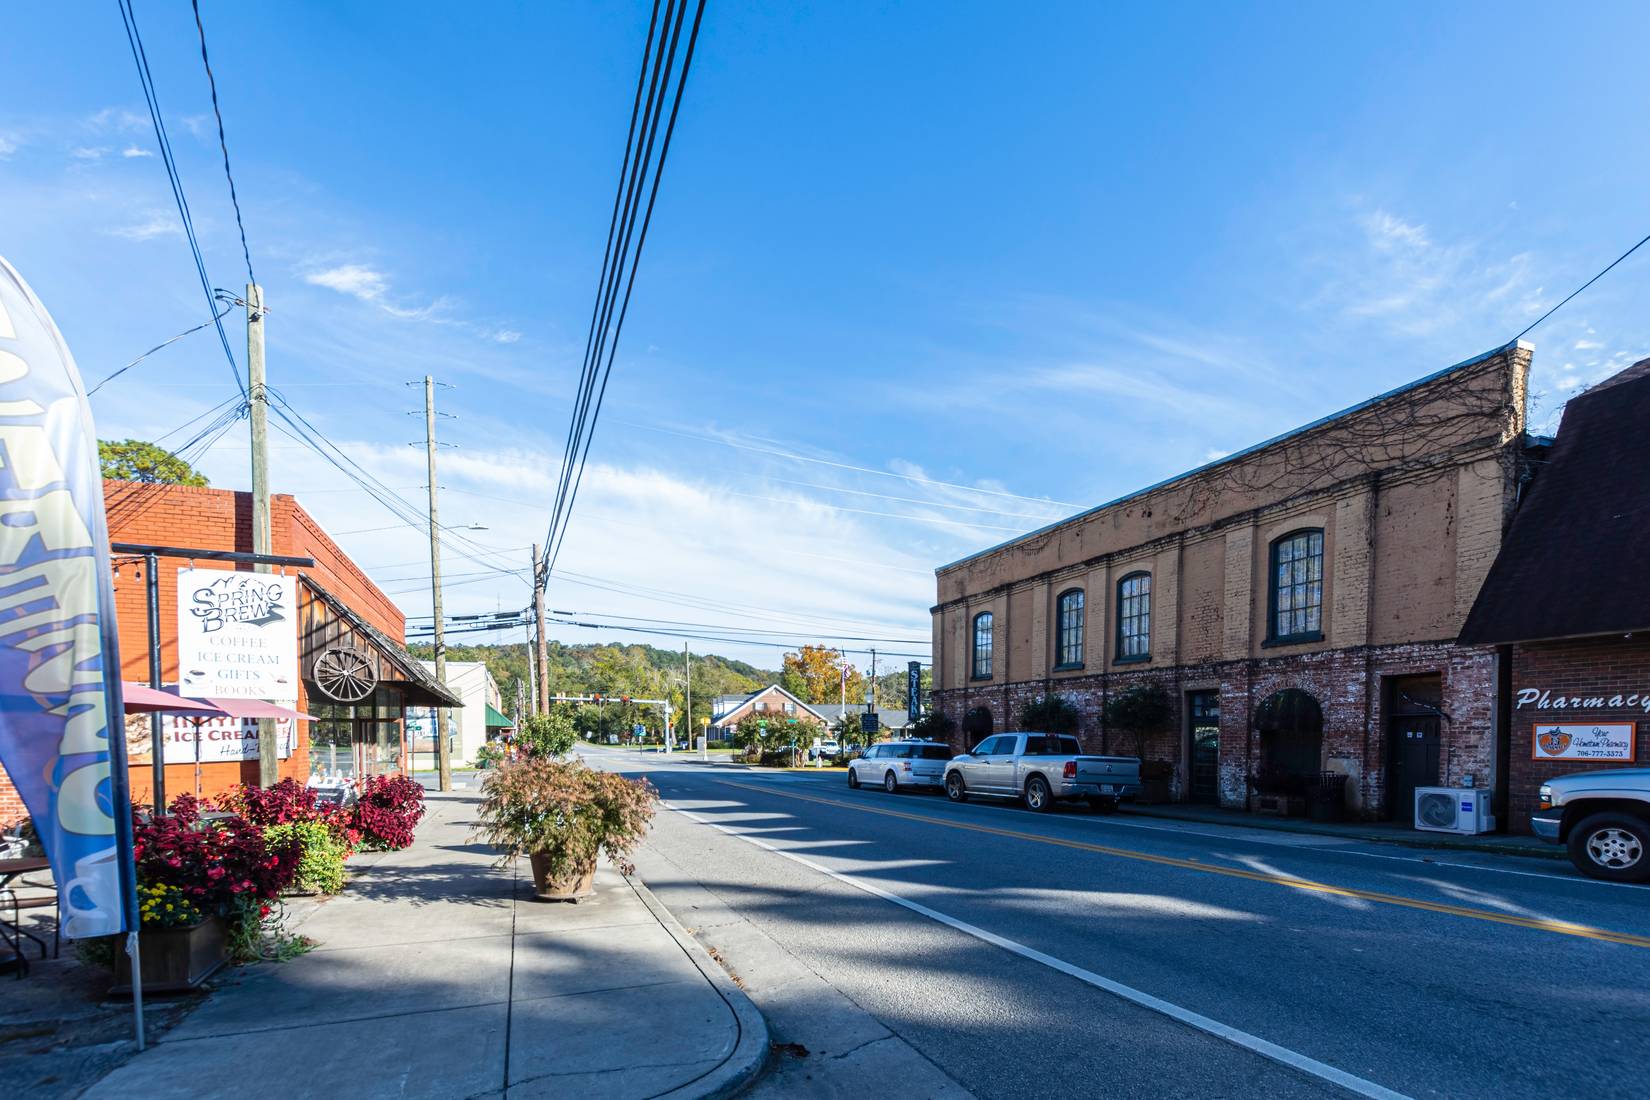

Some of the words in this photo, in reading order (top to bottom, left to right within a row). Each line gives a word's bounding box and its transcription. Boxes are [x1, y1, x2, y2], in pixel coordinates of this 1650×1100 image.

[190, 584, 283, 617] SPRING
[202, 601, 271, 633] BREW
[209, 636, 268, 648] COFFEE
[198, 651, 222, 662] ICE
[226, 653, 280, 665] CREAM
[217, 669, 261, 680] GIFTS
[215, 685, 266, 696] BOOKS
[1516, 688, 1650, 713] Pharmacy
[174, 731, 204, 743] ICE
[207, 730, 260, 741] CREA
